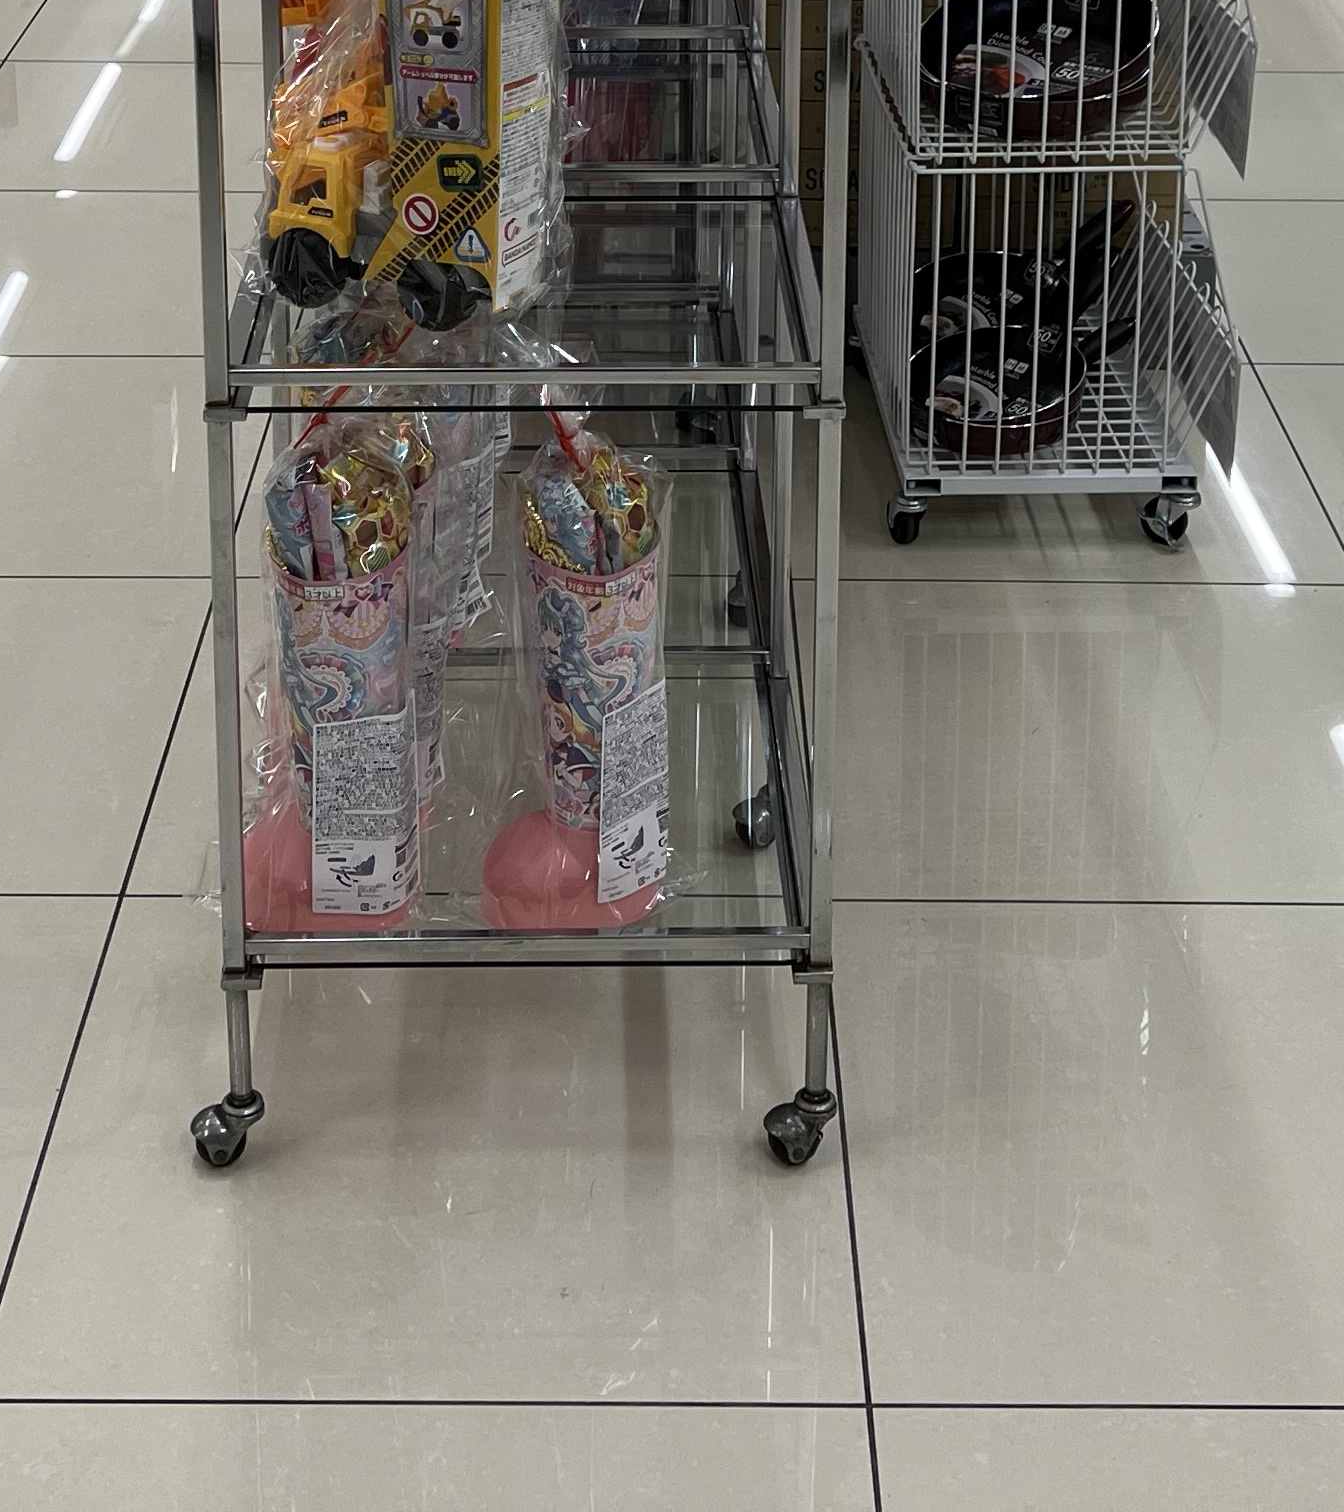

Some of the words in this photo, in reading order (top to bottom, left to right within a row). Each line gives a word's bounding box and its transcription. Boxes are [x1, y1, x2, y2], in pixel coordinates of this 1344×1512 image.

[607, 575, 638, 595] 3才以上
[305, 587, 344, 601] 3才以上
